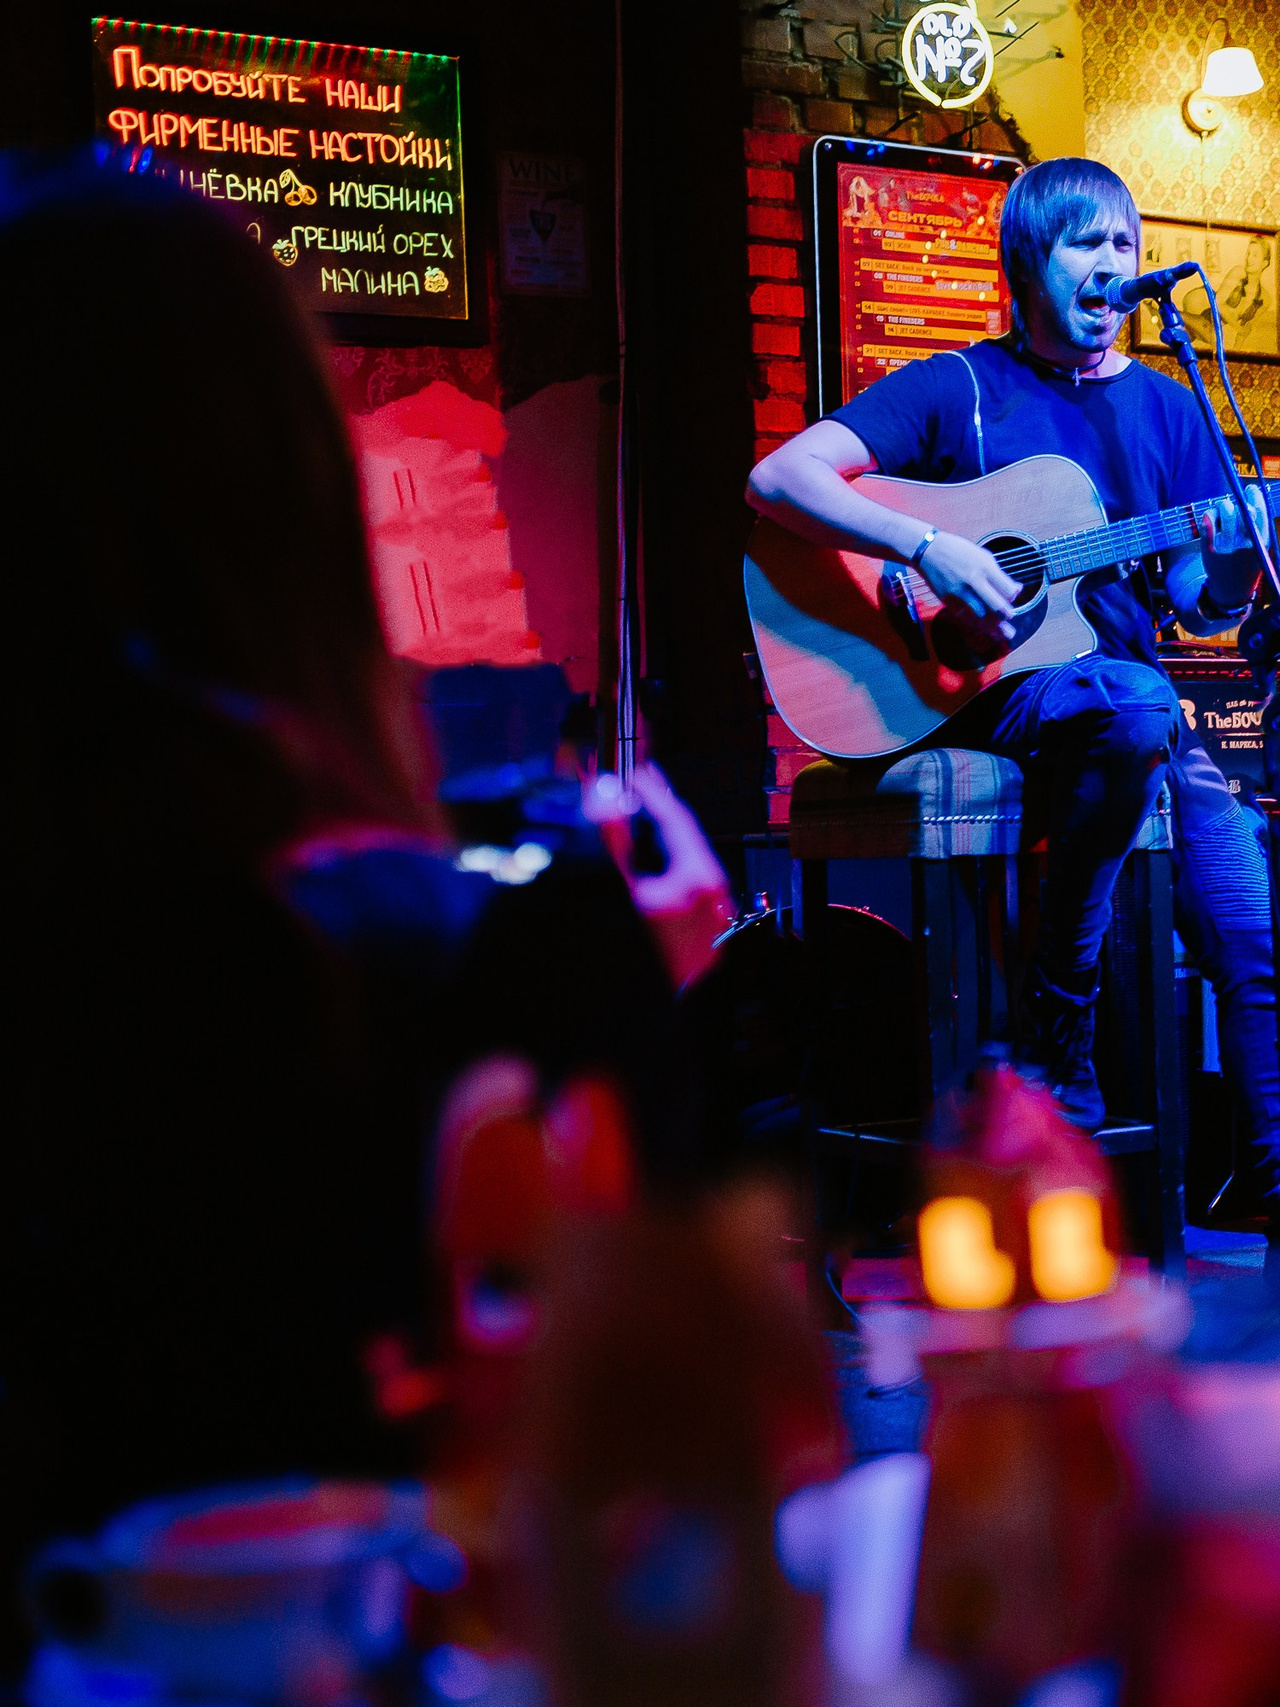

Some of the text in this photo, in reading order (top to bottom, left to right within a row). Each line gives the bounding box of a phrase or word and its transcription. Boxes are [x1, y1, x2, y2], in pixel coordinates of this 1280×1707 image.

[922, 13, 972, 39] OLD
[324, 77, 403, 114] НАШИ
[107, 107, 453, 172] ФИРМЕННЫЕ НАСТОЙКИ
[155, 167, 280, 204] НЁВКА
[329, 181, 454, 215] КЛУБНИКА
[888, 210, 963, 228] СЕНТЯБРЬ
[291, 223, 386, 253] ГРЕЦКИЙ
[392, 231, 455, 259] ОРЕХ
[320, 266, 420, 296] МАЛИНА
